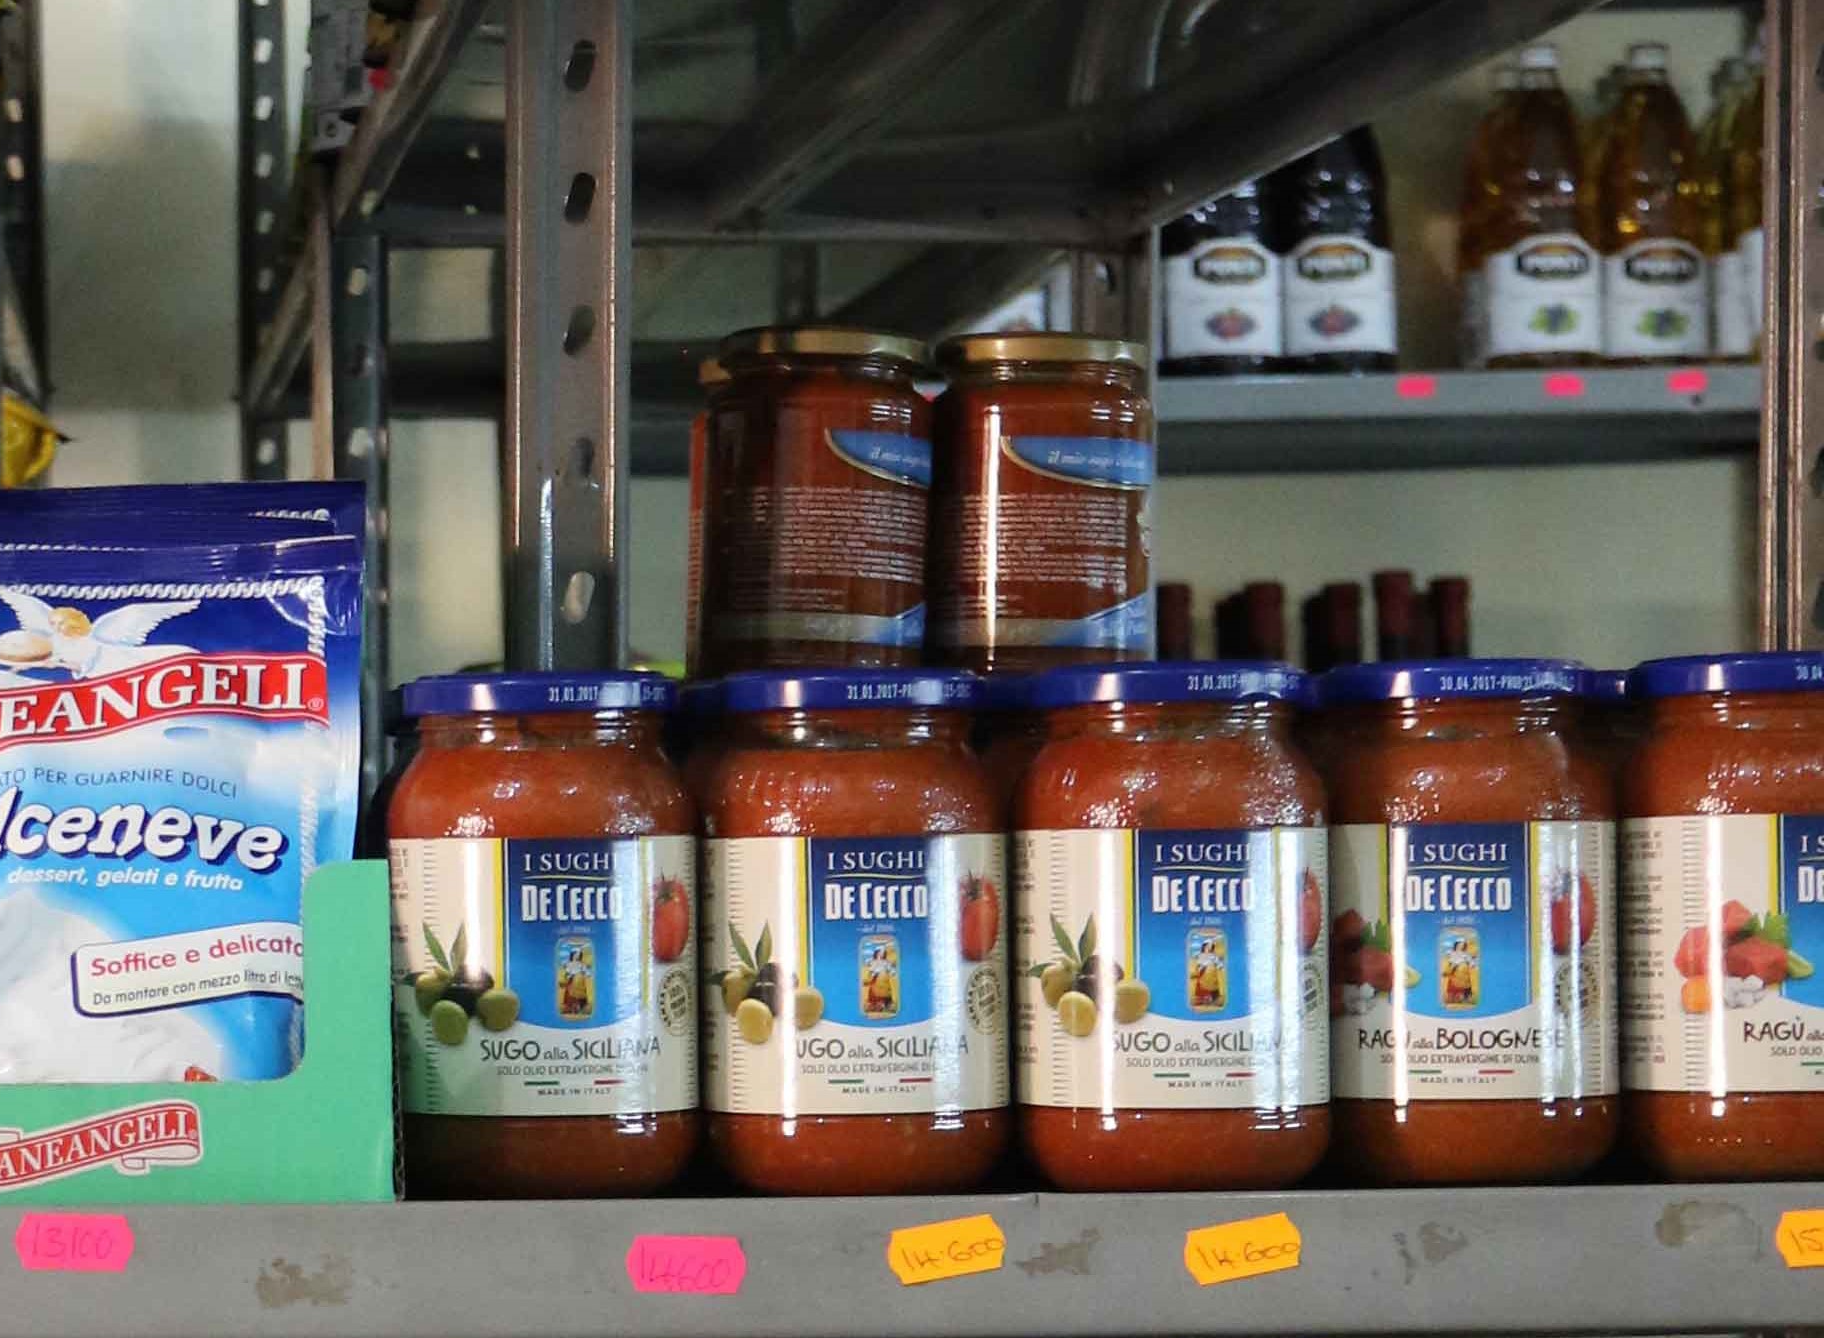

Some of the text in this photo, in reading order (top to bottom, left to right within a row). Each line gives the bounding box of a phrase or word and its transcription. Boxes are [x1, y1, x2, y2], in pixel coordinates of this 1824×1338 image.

[33, 768, 69, 784] PER
[74, 767, 176, 786] GUARNIRE
[181, 770, 238, 798] DOLCI
[841, 850, 924, 872] SUGHI
[1172, 844, 1252, 864] SUGHI
[1424, 843, 1508, 863] SUGHI
[8, 866, 89, 887] dessert,
[95, 868, 160, 889] gelati
[164, 873, 178, 886] e
[184, 870, 242, 891] frutta
[521, 884, 622, 922] DE CECCO
[825, 882, 928, 921] DE CECCO
[1152, 873, 1255, 913] DE CECCO
[1406, 872, 1512, 912] DE CECCO
[91, 949, 200, 976] Soffice e
[94, 969, 266, 1005] Da montare con mezzo litro
[1743, 1015, 1806, 1043] RAGÙ
[480, 1038, 540, 1062] SUGO
[545, 1044, 569, 1061] alla
[848, 1044, 873, 1061] alla
[1174, 1040, 1201, 1052] alla
[1431, 1054, 1500, 1064] EXTRAVERGINE
